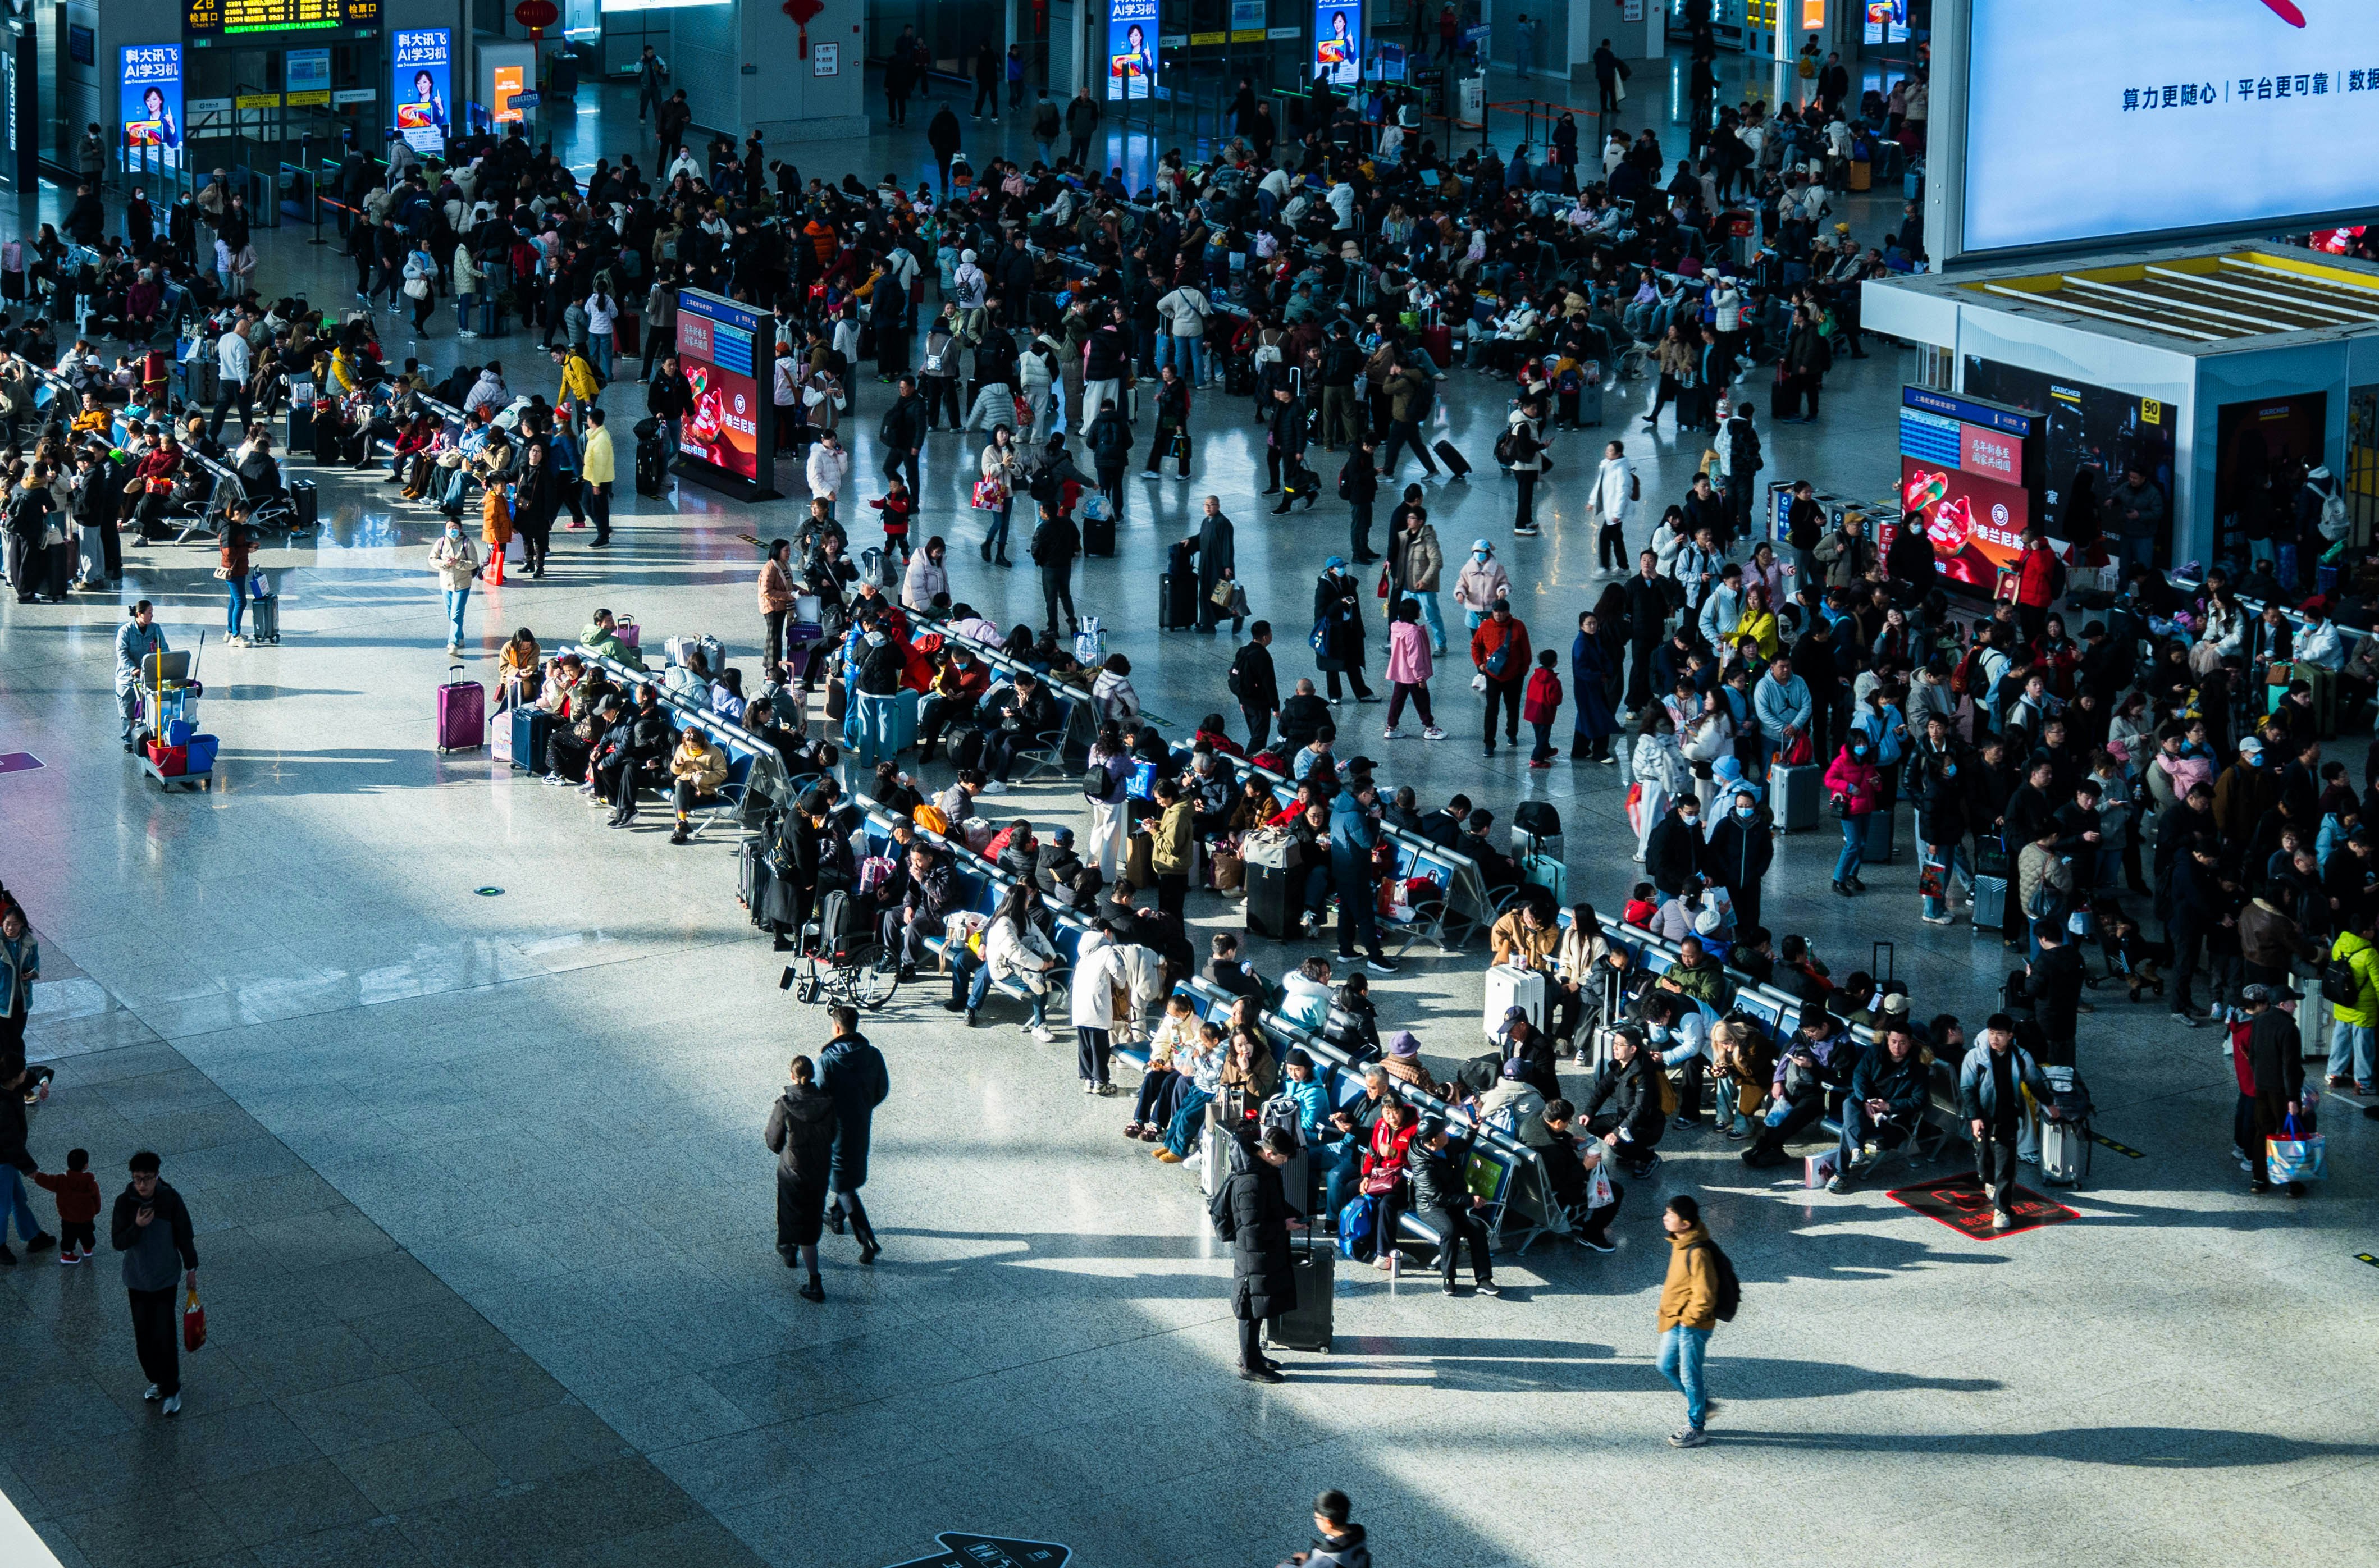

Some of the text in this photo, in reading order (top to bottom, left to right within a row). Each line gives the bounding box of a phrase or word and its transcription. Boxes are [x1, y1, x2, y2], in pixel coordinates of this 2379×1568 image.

[349, 3, 376, 14] 检票口
[1112, 3, 1156, 16] AI学习机
[189, 12, 218, 23] 检票口
[398, 32, 447, 48] 科大讯飞
[126, 48, 179, 64] 科大讯飞
[397, 47, 447, 62] AI学习机
[124, 62, 179, 79] AI学习机
[2122, 68, 2379, 112] 算力更随心 平台更可靠 数据
[684, 323, 707, 340] 马年新春至
[2051, 385, 2081, 397] KÄRCHER
[2144, 401, 2158, 414] 90
[2259, 406, 2290, 416] KÄRCHER
[725, 413, 756, 436] 泰兰尼斯
[1972, 440, 2010, 459] 马年新春至
[1972, 451, 2011, 473] 阖家共团圆
[1977, 524, 2024, 551] 泰兰尼斯
